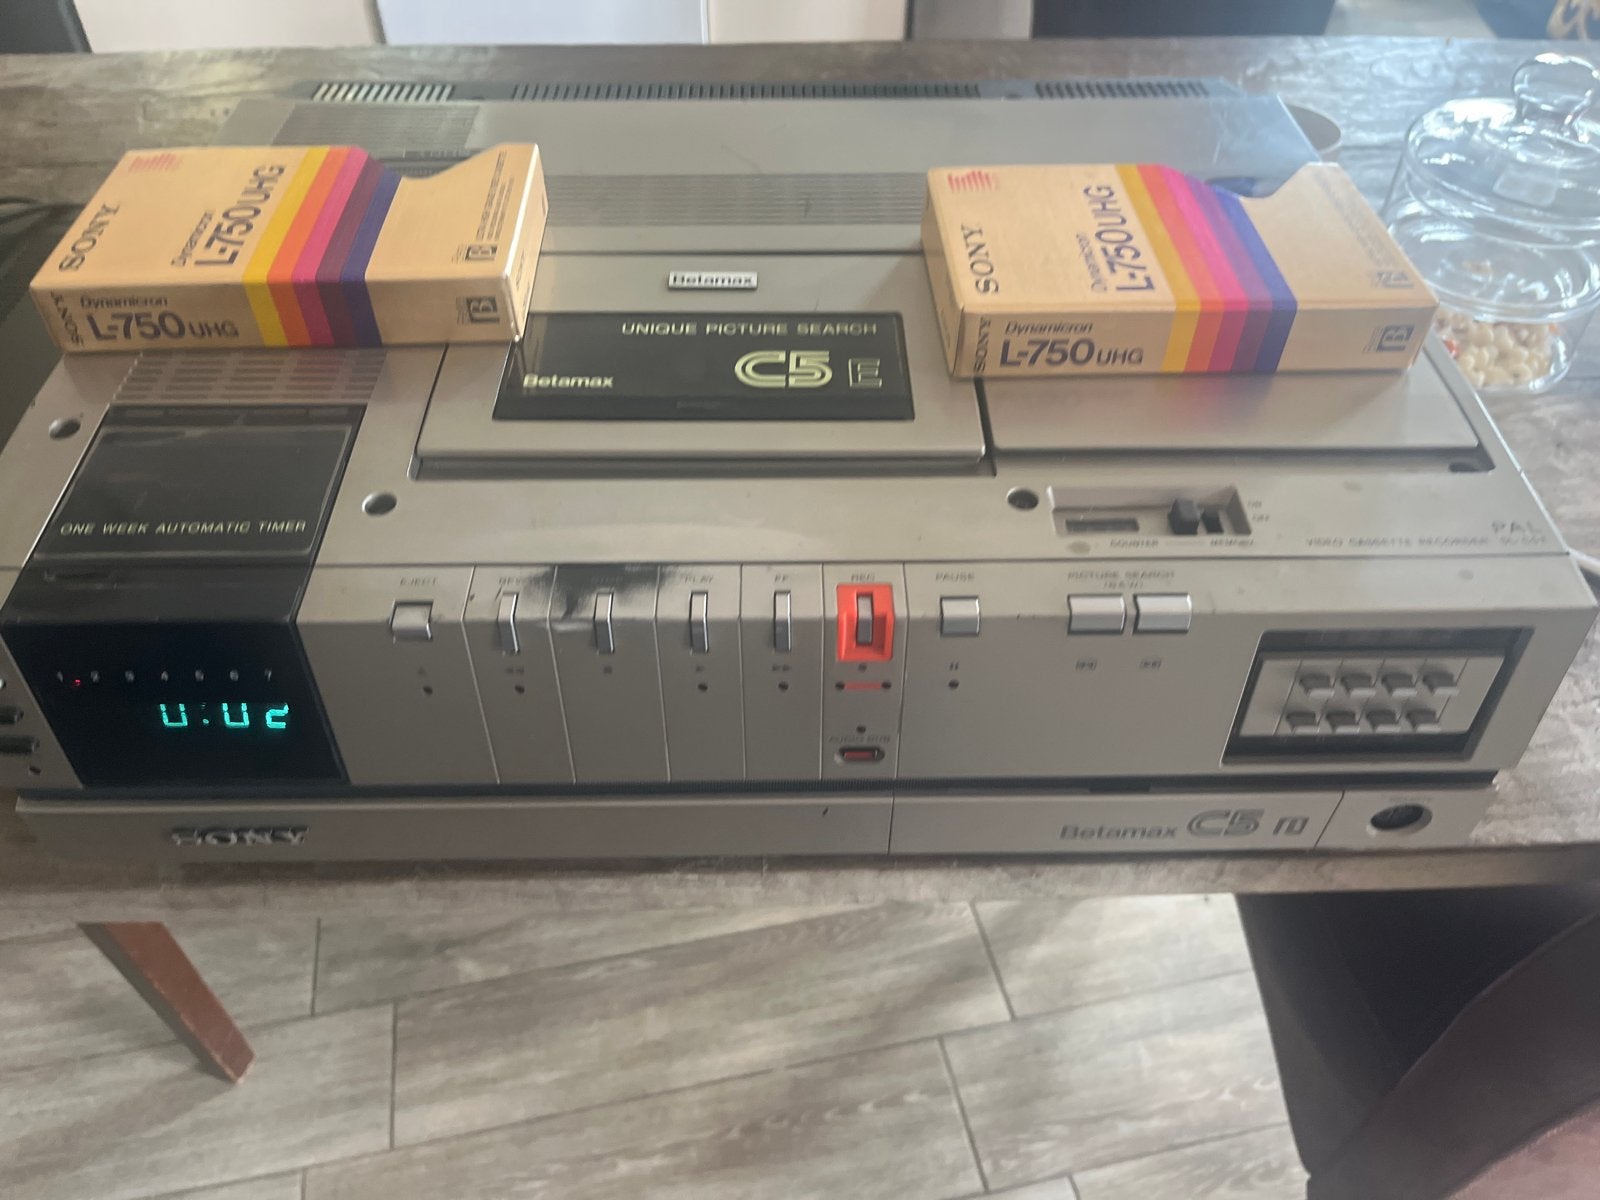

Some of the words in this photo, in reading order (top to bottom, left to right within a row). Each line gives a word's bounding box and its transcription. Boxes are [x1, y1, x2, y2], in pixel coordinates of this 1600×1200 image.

[59, 203, 120, 272] SONY
[961, 224, 999, 295] SONY
[671, 273, 754, 287] Betamax
[86, 310, 186, 340] L-750
[621, 321, 697, 337] UNIQUE
[705, 321, 788, 337] PICTURE
[796, 321, 877, 337] SEARCH
[1004, 320, 1094, 337] Dynamicron
[972, 316, 991, 374] SONY
[999, 337, 1096, 369] L-750
[1096, 347, 1145, 365] UHG
[523, 373, 614, 389] Betamax
[60, 522, 96, 537] ONE
[102, 522, 150, 536] WEEK
[155, 521, 250, 536] AUTOMATIC
[258, 519, 306, 534] TIMER
[1060, 825, 1178, 840] Betamax
